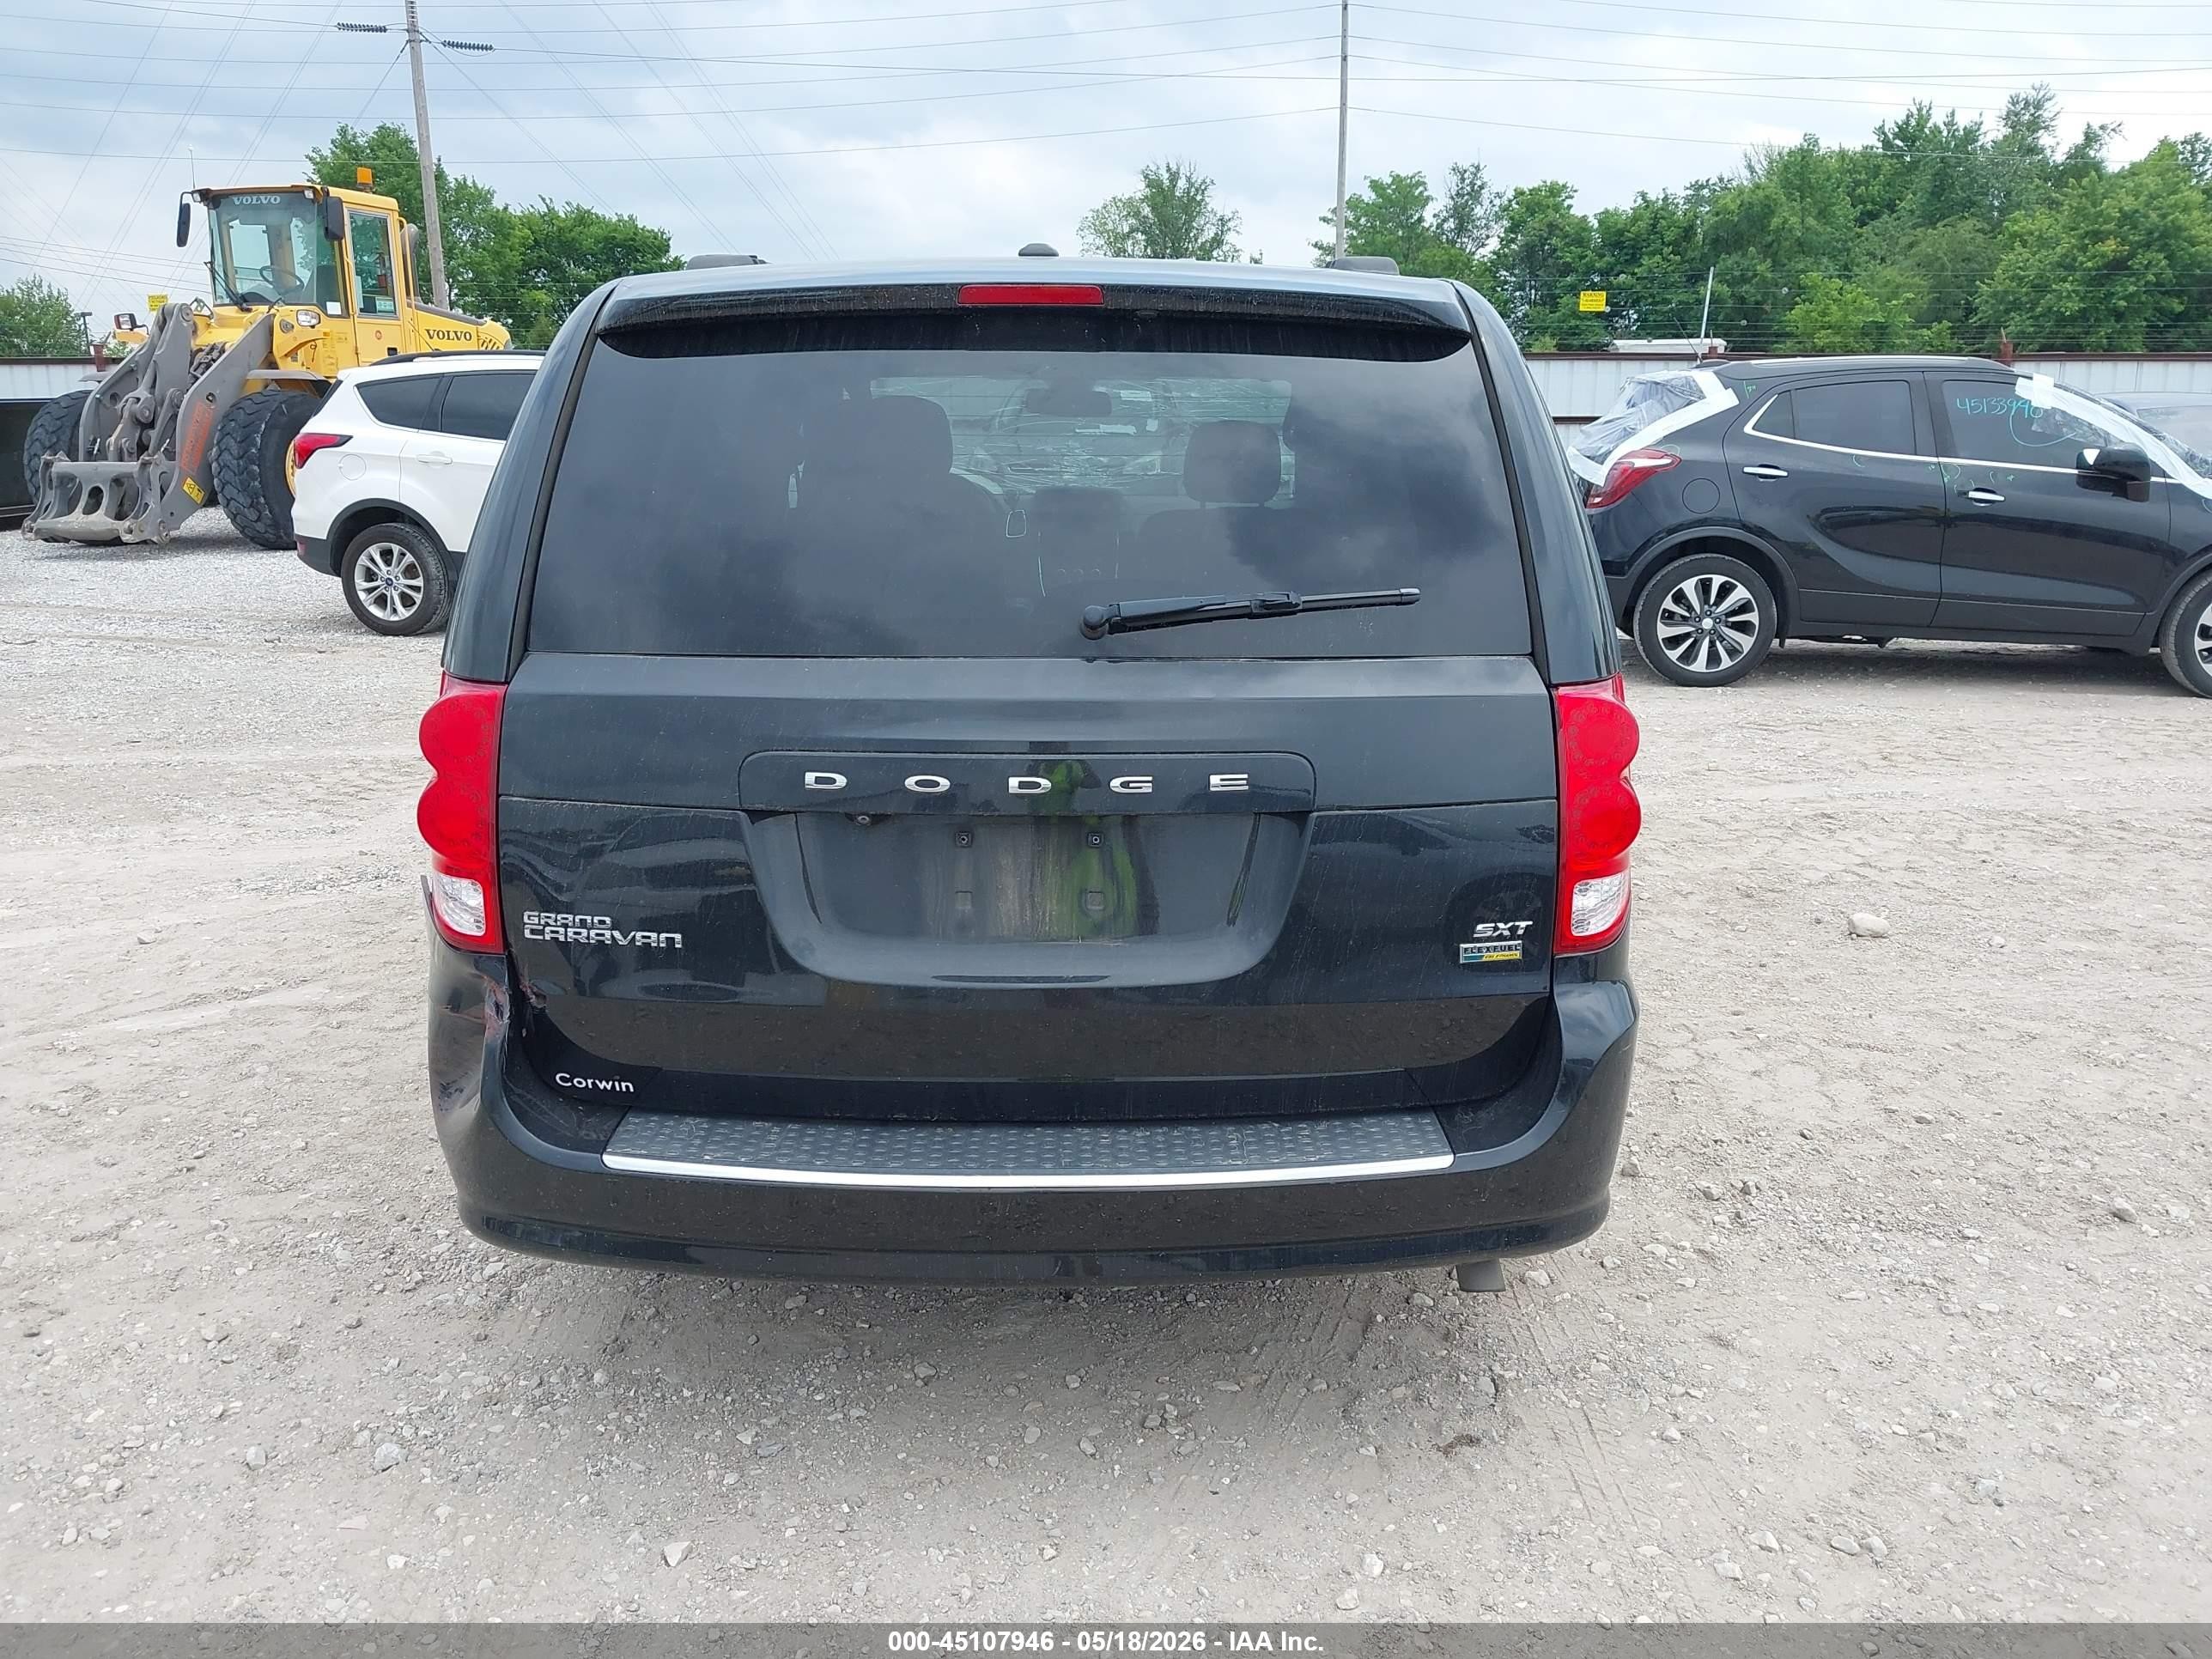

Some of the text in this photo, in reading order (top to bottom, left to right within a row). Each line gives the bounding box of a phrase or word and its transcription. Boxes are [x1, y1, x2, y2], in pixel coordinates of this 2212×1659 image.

[233, 195, 281, 205] VOLVO
[425, 329, 472, 342] VOLVO
[805, 771, 1249, 794] DODGE
[523, 911, 612, 929] GRAND
[524, 925, 683, 949] CARAVAN
[1473, 921, 1534, 938] SXT
[555, 1073, 635, 1092] Corwin
